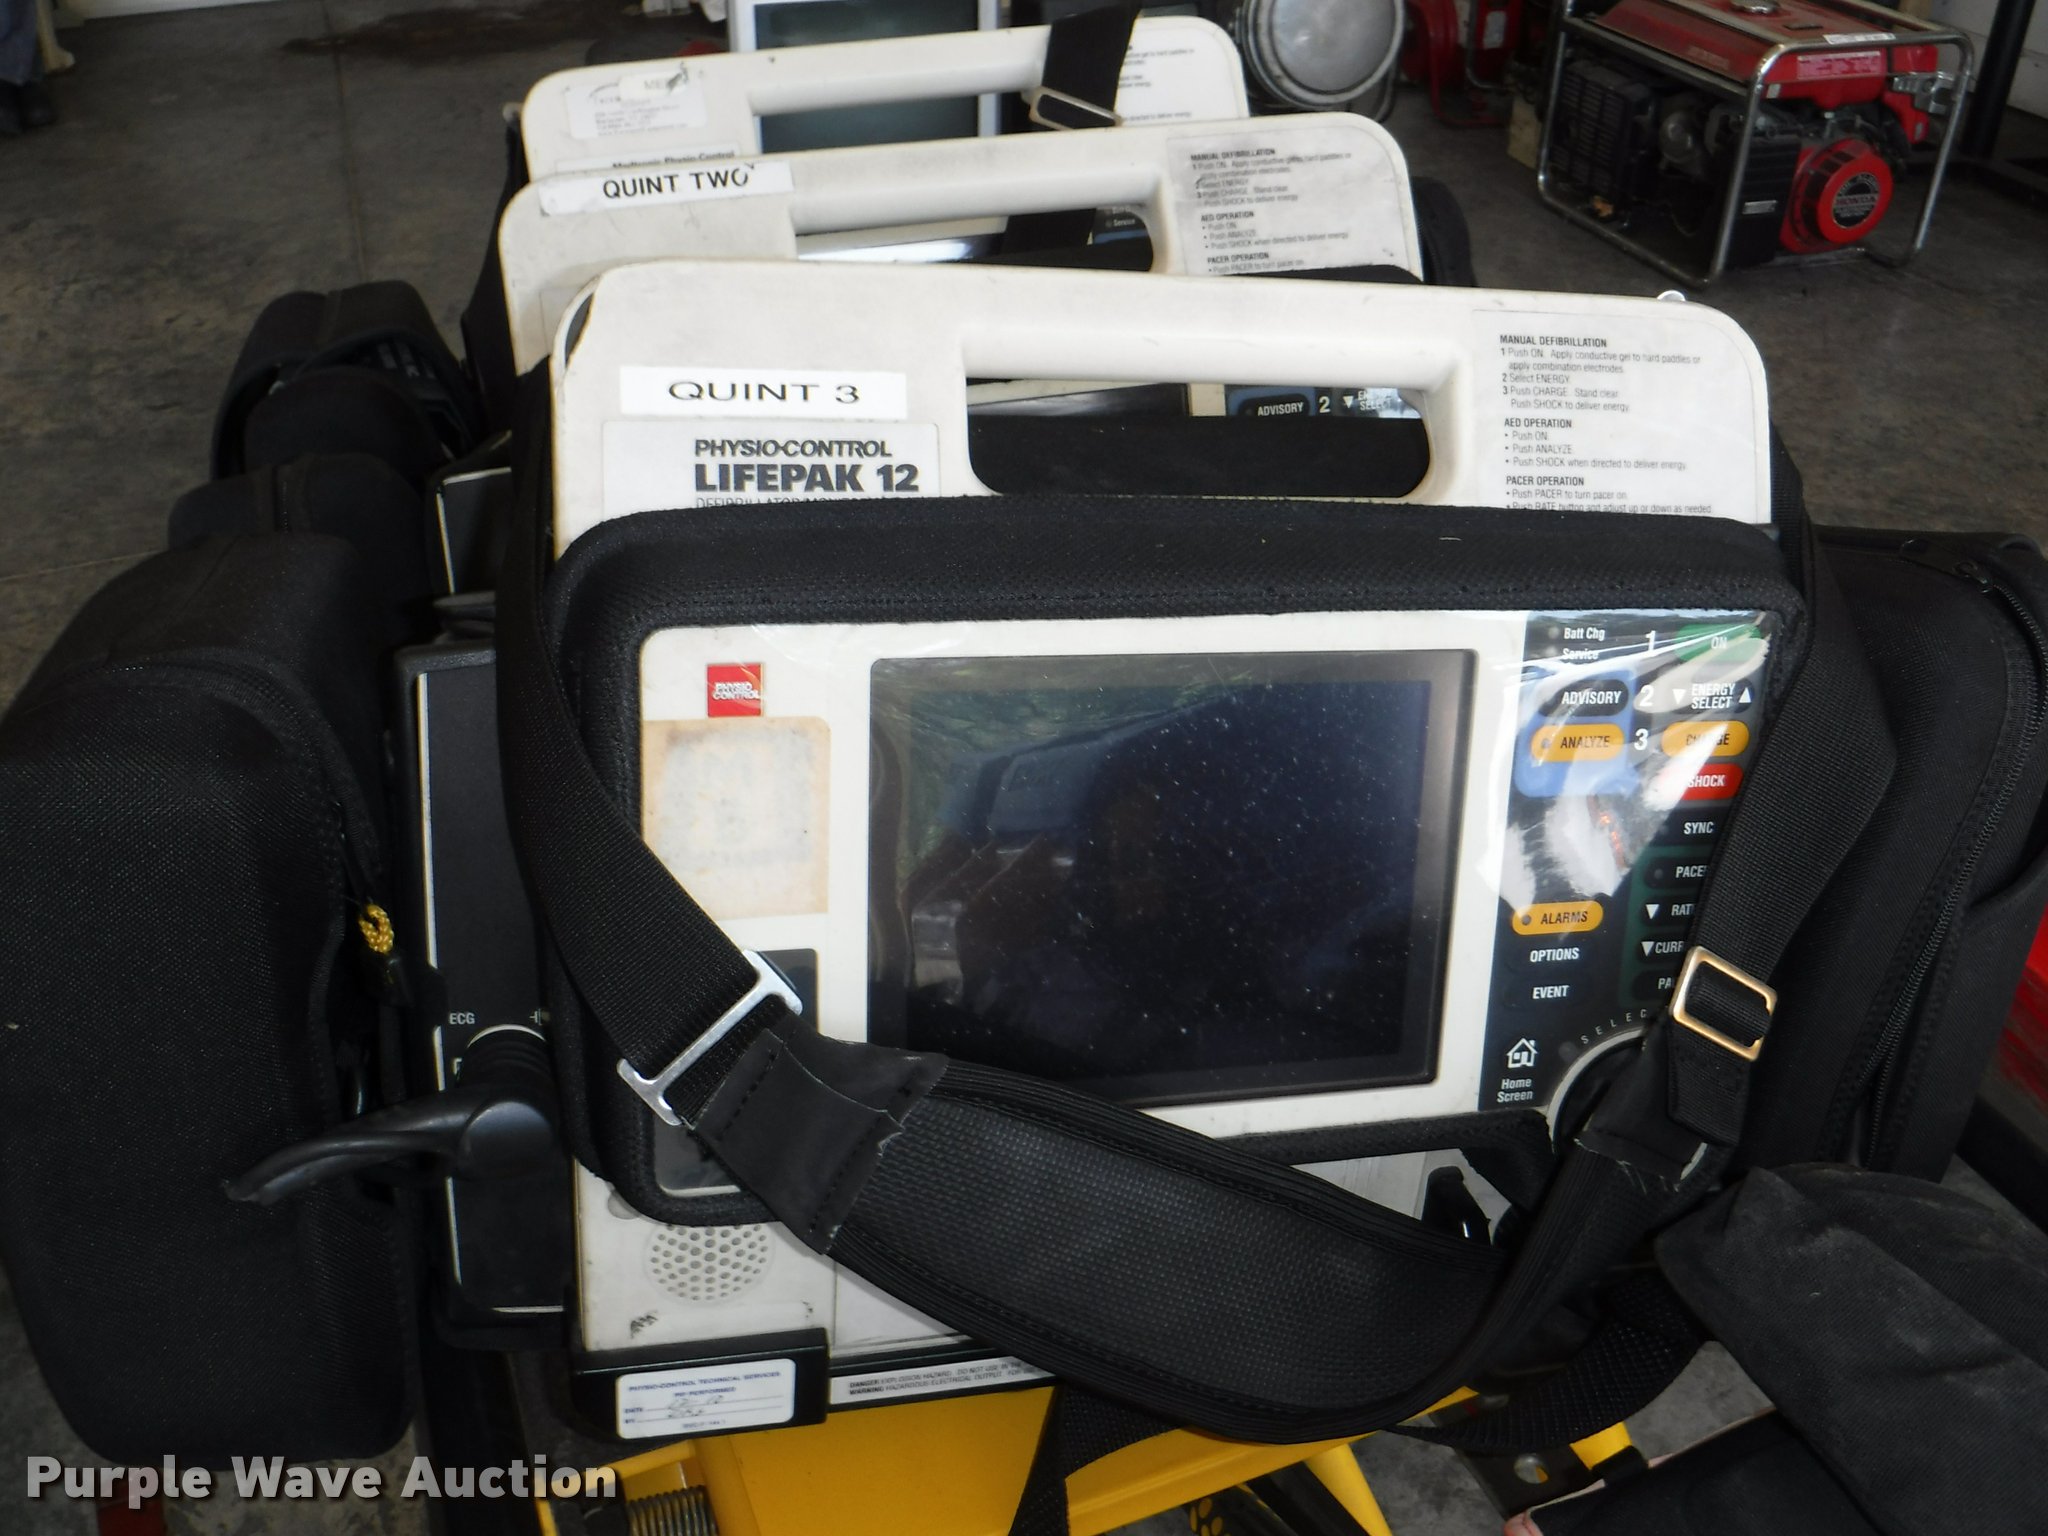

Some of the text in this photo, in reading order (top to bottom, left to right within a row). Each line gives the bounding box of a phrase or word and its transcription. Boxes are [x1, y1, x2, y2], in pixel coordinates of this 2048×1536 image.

[1191, 153, 1219, 161] MANUAL
[603, 168, 748, 199] QUINT TWO
[1201, 210, 1254, 222] AED OPERATION
[1207, 252, 1269, 264] PACER OPERATION
[1500, 335, 1607, 348] MANUAL DEFIBRILLATION
[1501, 348, 1505, 357] 1
[1508, 348, 1529, 357] Push
[1550, 349, 1573, 360] Apply
[1575, 350, 1618, 361] conductive
[1619, 352, 1631, 362] gel
[1633, 352, 1640, 361] to
[1642, 353, 1660, 363] hard
[1662, 354, 1691, 365] paddles
[1692, 355, 1700, 364] or
[1509, 362, 1530, 371] apply
[1532, 362, 1582, 372] combination
[1502, 373, 1507, 382] 2
[1509, 373, 1534, 383] Select
[668, 381, 860, 404] QUINT 3
[1502, 387, 1508, 395] 3
[1510, 386, 1531, 396] Push
[1575, 388, 1597, 398] Stand
[1257, 396, 1330, 416] ADVISORY 2
[1511, 399, 1531, 408] Push
[1533, 399, 1563, 409] SHOCK
[1565, 400, 1573, 409] to
[1575, 401, 1601, 411] deliver
[1504, 418, 1572, 428] AED OPERATION
[1512, 431, 1533, 440] Push
[694, 439, 892, 458] PHYSIO-CONTROL
[1513, 444, 1534, 453] Push
[1513, 457, 1534, 466] Push
[1536, 457, 1565, 467] SHOCK
[1567, 459, 1589, 467] when
[1591, 459, 1622, 468] directed
[1623, 460, 1632, 469] to
[1633, 460, 1659, 470] deliver
[694, 463, 920, 492] LIFEPAK 12
[1506, 476, 1584, 486] PACER OPERATION
[1513, 489, 1533, 498] Push
[1534, 489, 1562, 499] PACER
[1565, 490, 1573, 499] to
[1575, 490, 1591, 499] turn
[1593, 491, 1614, 501] pacer
[1513, 502, 1682, 514] Push RATE button and adjust up or down as
[1564, 628, 1605, 642] Batt Chg
[1646, 630, 1656, 652] 1
[1711, 637, 1728, 650] ON
[1562, 648, 1598, 661] Service
[1639, 685, 1654, 707] 2
[1692, 684, 1735, 697] ENERGY
[1561, 691, 1622, 705] ADVISORY
[1691, 696, 1732, 709] SELECT
[1560, 736, 1610, 749] ANALYZE
[1633, 728, 1649, 750] 3
[1686, 733, 1729, 746] CHGE
[1688, 775, 1725, 788] SHOCK
[1683, 821, 1714, 835] SYNC
[1675, 864, 1709, 879] PACE
[1671, 903, 1696, 917] RAT
[1540, 910, 1588, 925] ALARMS
[1529, 947, 1580, 963] OPTIONS
[1533, 985, 1570, 999] EVENT
[449, 1012, 475, 1025] ECG
[1581, 1008, 1648, 1044] SELEC
[1502, 1078, 1531, 1089] Home
[1497, 1089, 1533, 1103] Screen
[850, 1379, 879, 1388] DANGER
[850, 1387, 884, 1395] WARNING
